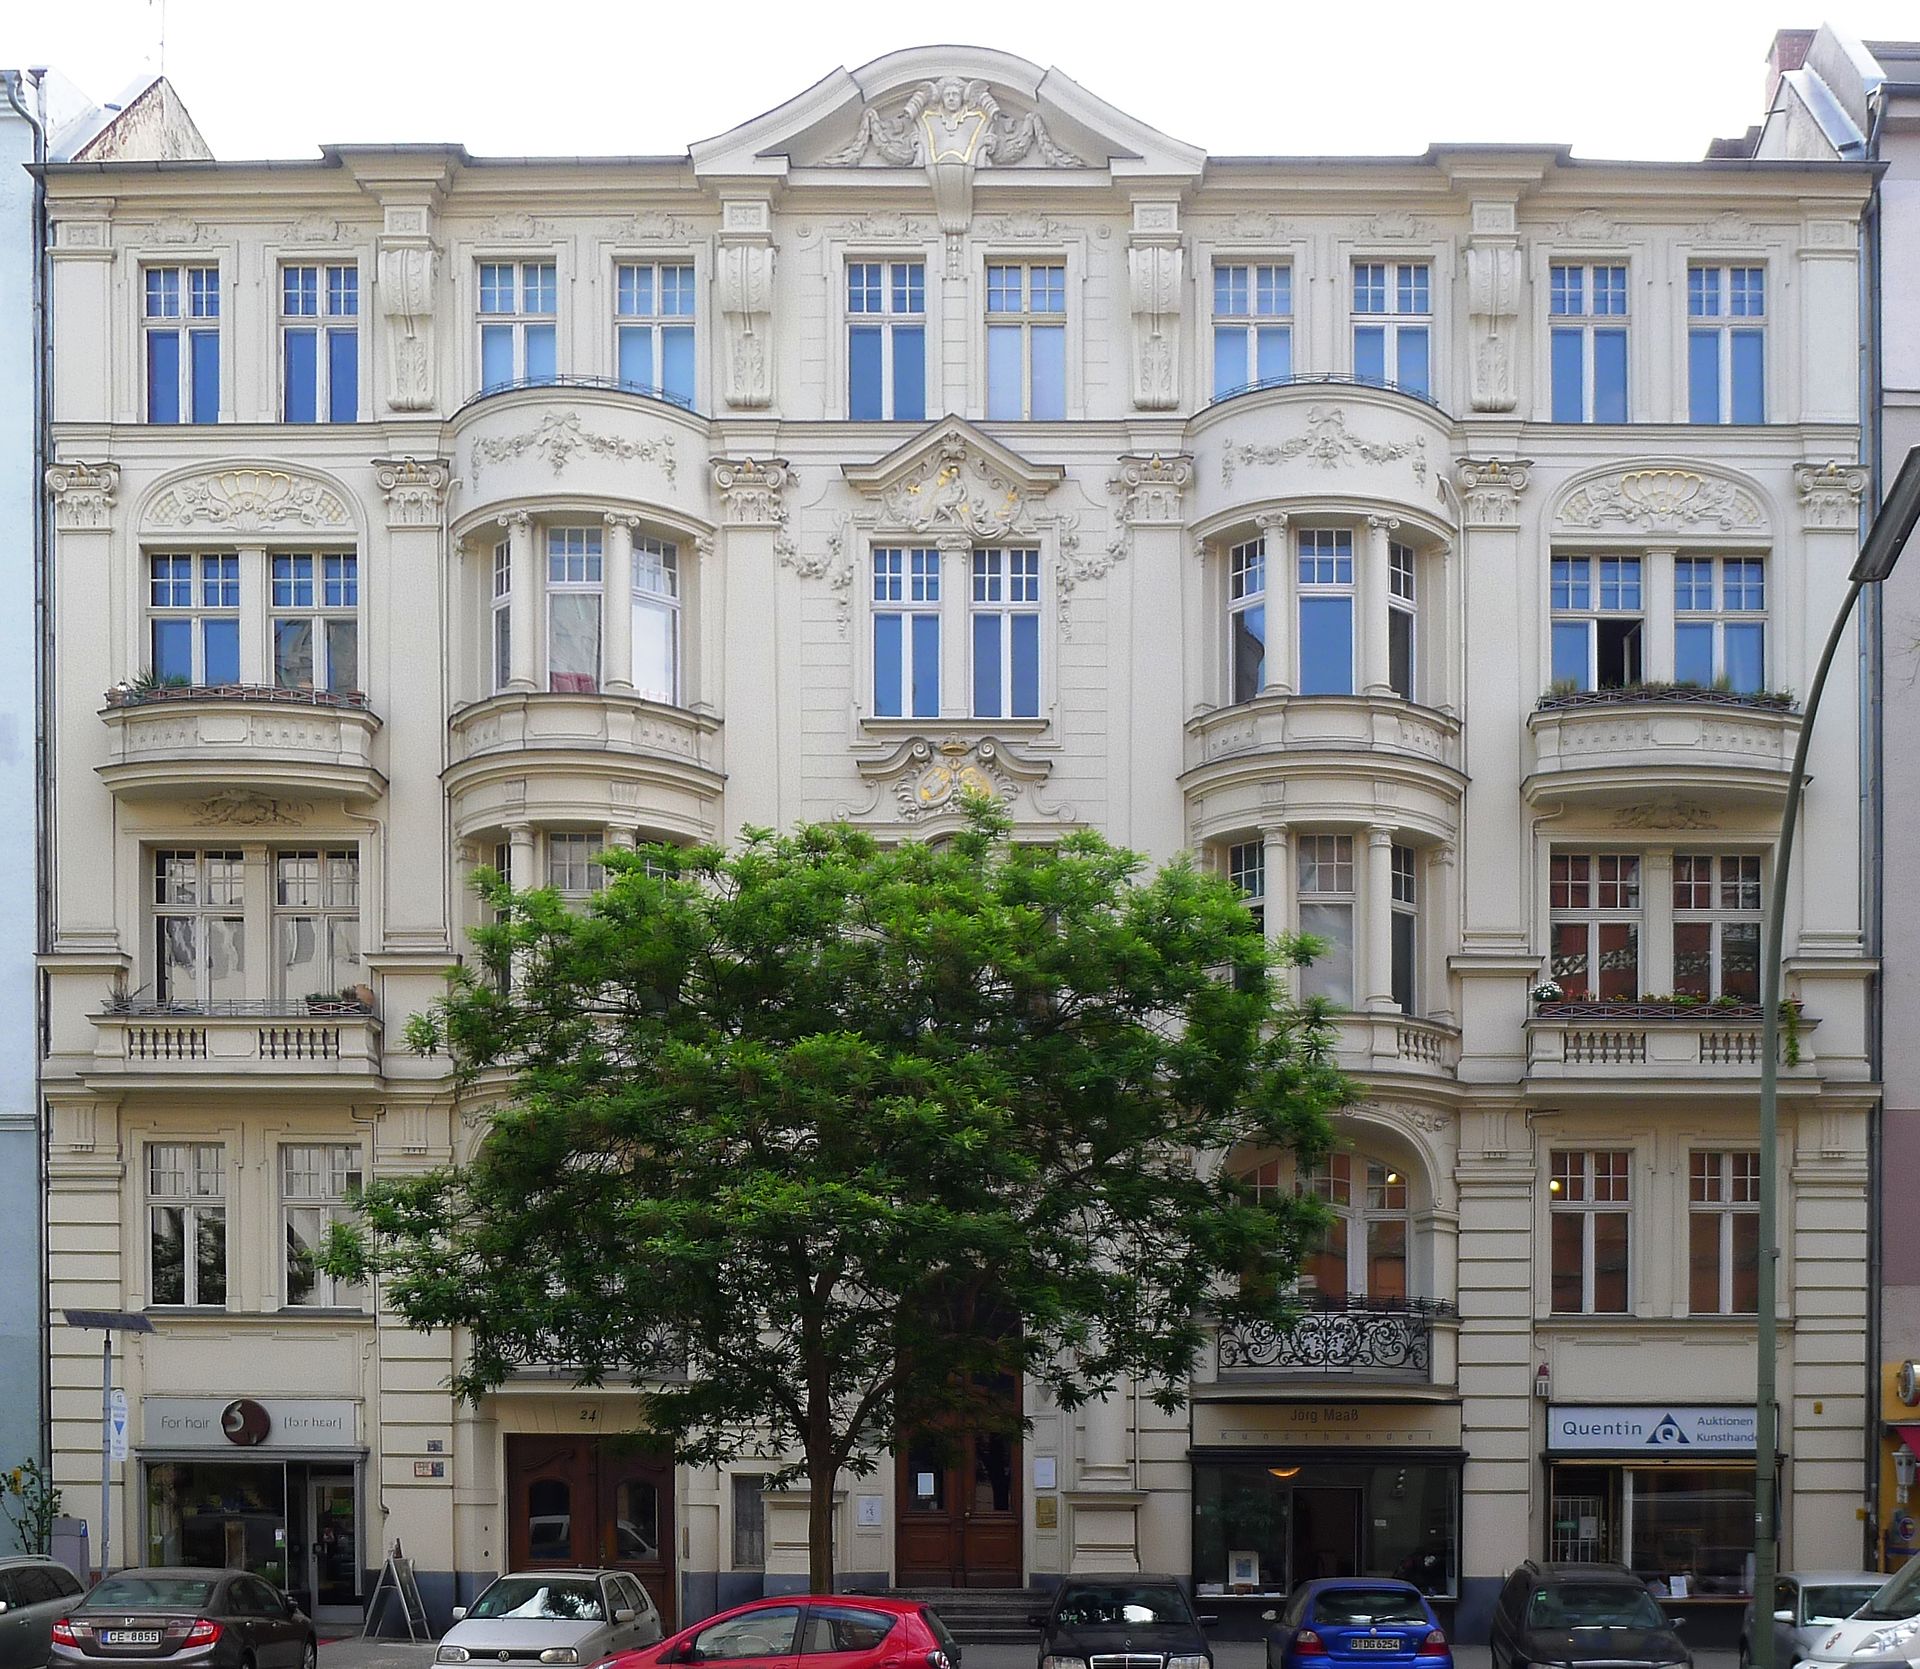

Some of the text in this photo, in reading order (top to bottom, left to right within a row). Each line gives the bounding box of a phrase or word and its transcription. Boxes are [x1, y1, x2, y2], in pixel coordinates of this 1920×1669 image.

[579, 1408, 597, 1423] 24
[1323, 1408, 1359, 1421] Maaß
[1697, 1416, 1753, 1426] Auktionen
[161, 1415, 210, 1429] For hair
[1562, 1421, 1642, 1435] Quentin
